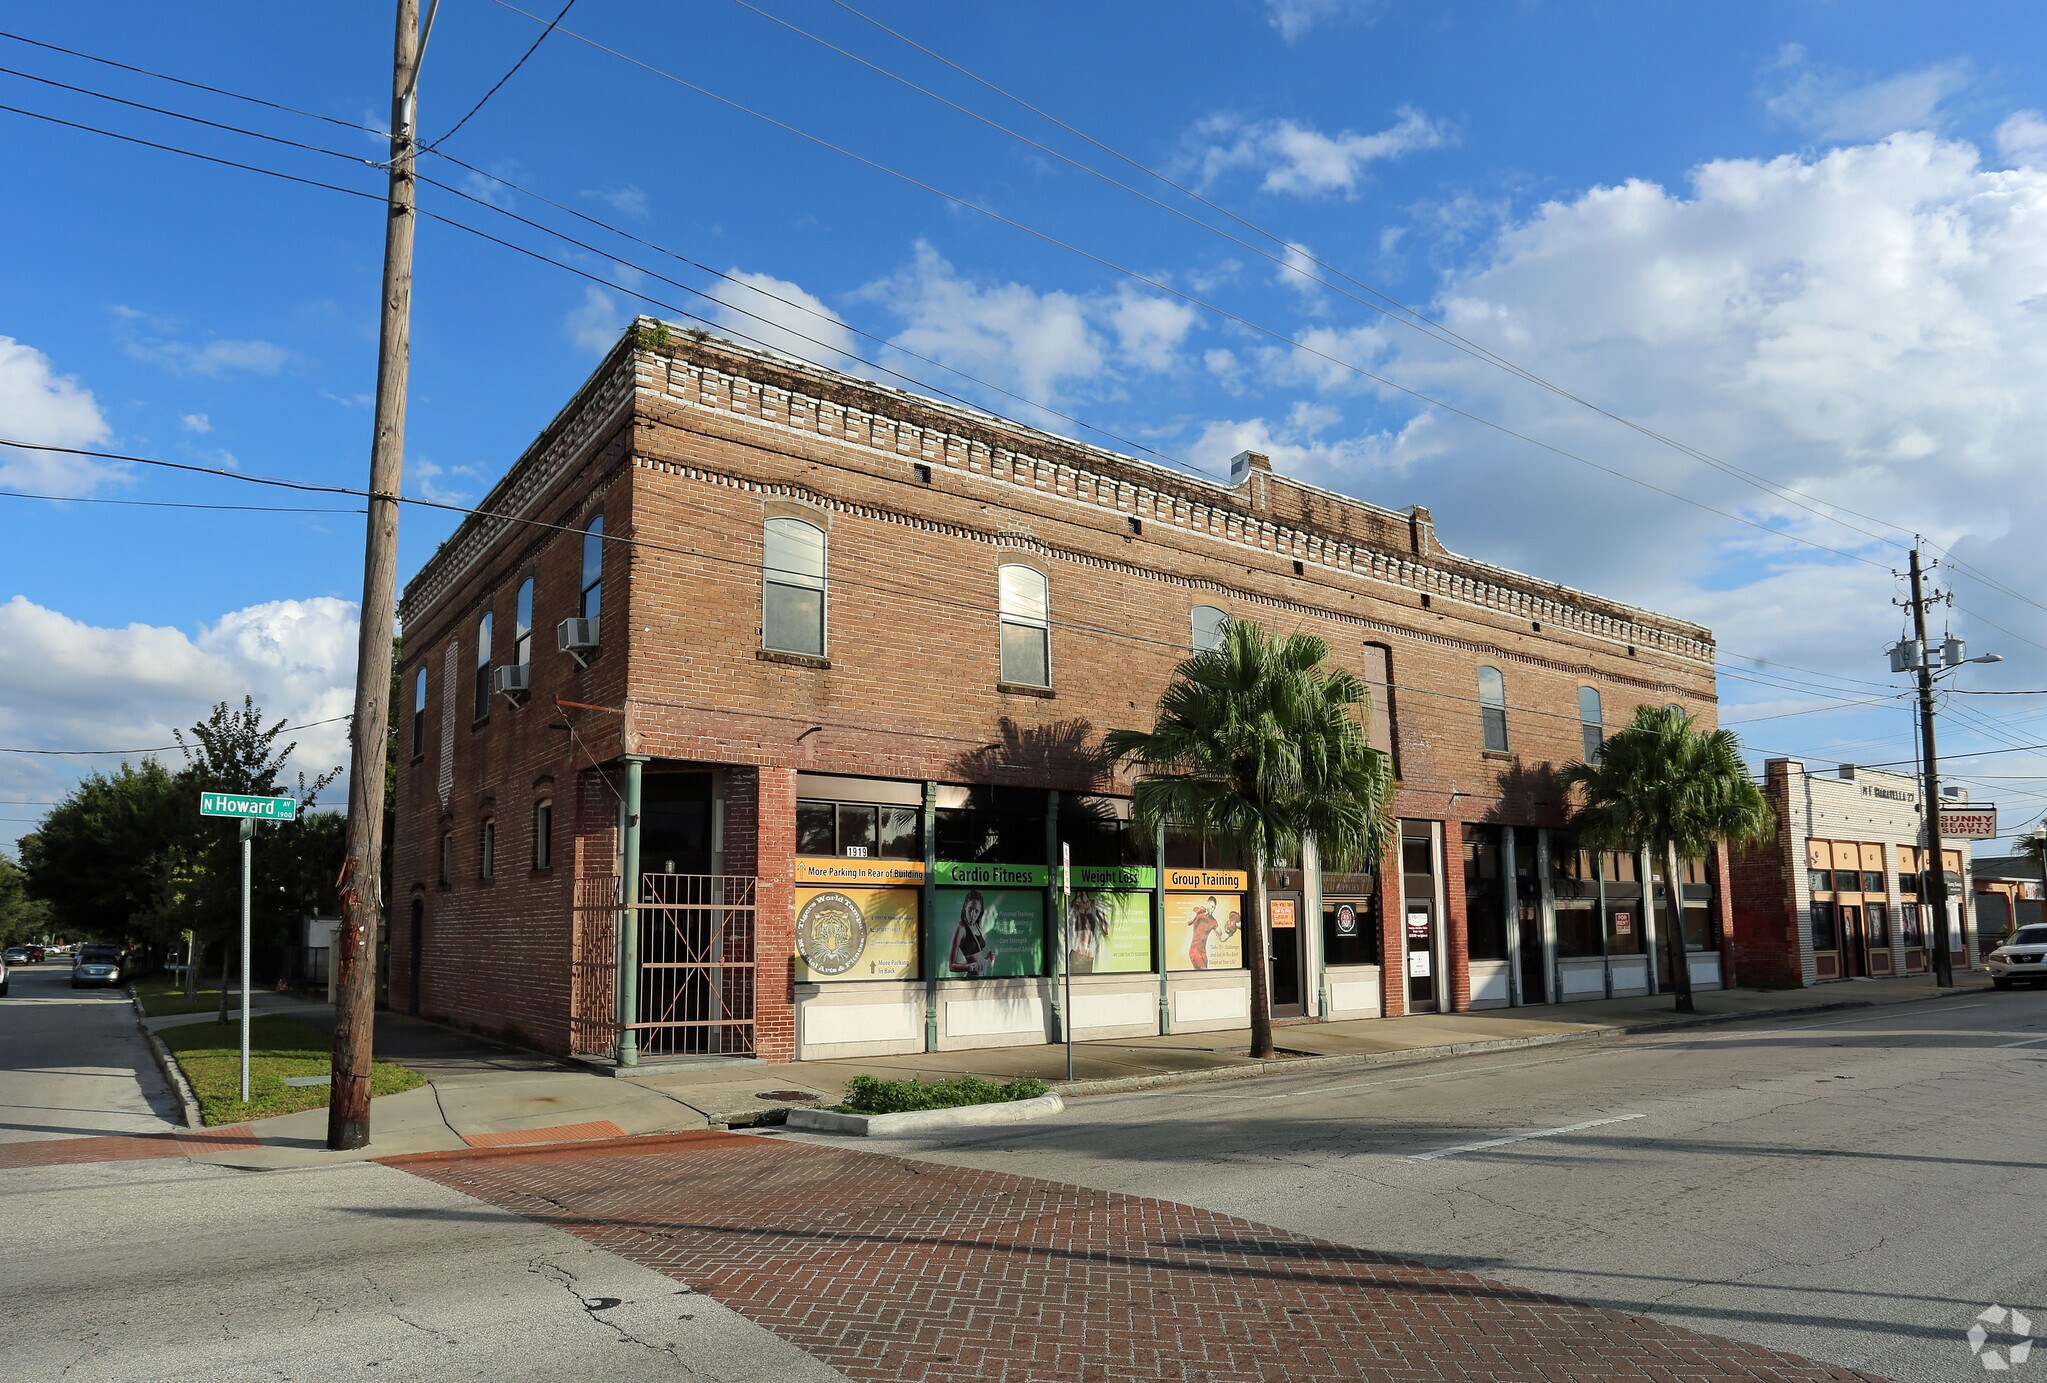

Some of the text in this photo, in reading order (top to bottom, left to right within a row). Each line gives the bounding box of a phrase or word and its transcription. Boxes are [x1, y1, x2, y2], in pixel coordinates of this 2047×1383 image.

[204, 798, 212, 810] N
[216, 796, 274, 815] Howard
[848, 847, 867, 857] 1919
[808, 866, 923, 880] More Parking In Rear of Building
[951, 866, 1033, 883] Cardio Fitness
[1081, 869, 1138, 886] Weight Loss
[1172, 872, 1239, 888] Group Training
[798, 895, 863, 929] Tigers World Tampa
[798, 938, 818, 969] Martial
[846, 938, 865, 968] Fitness
